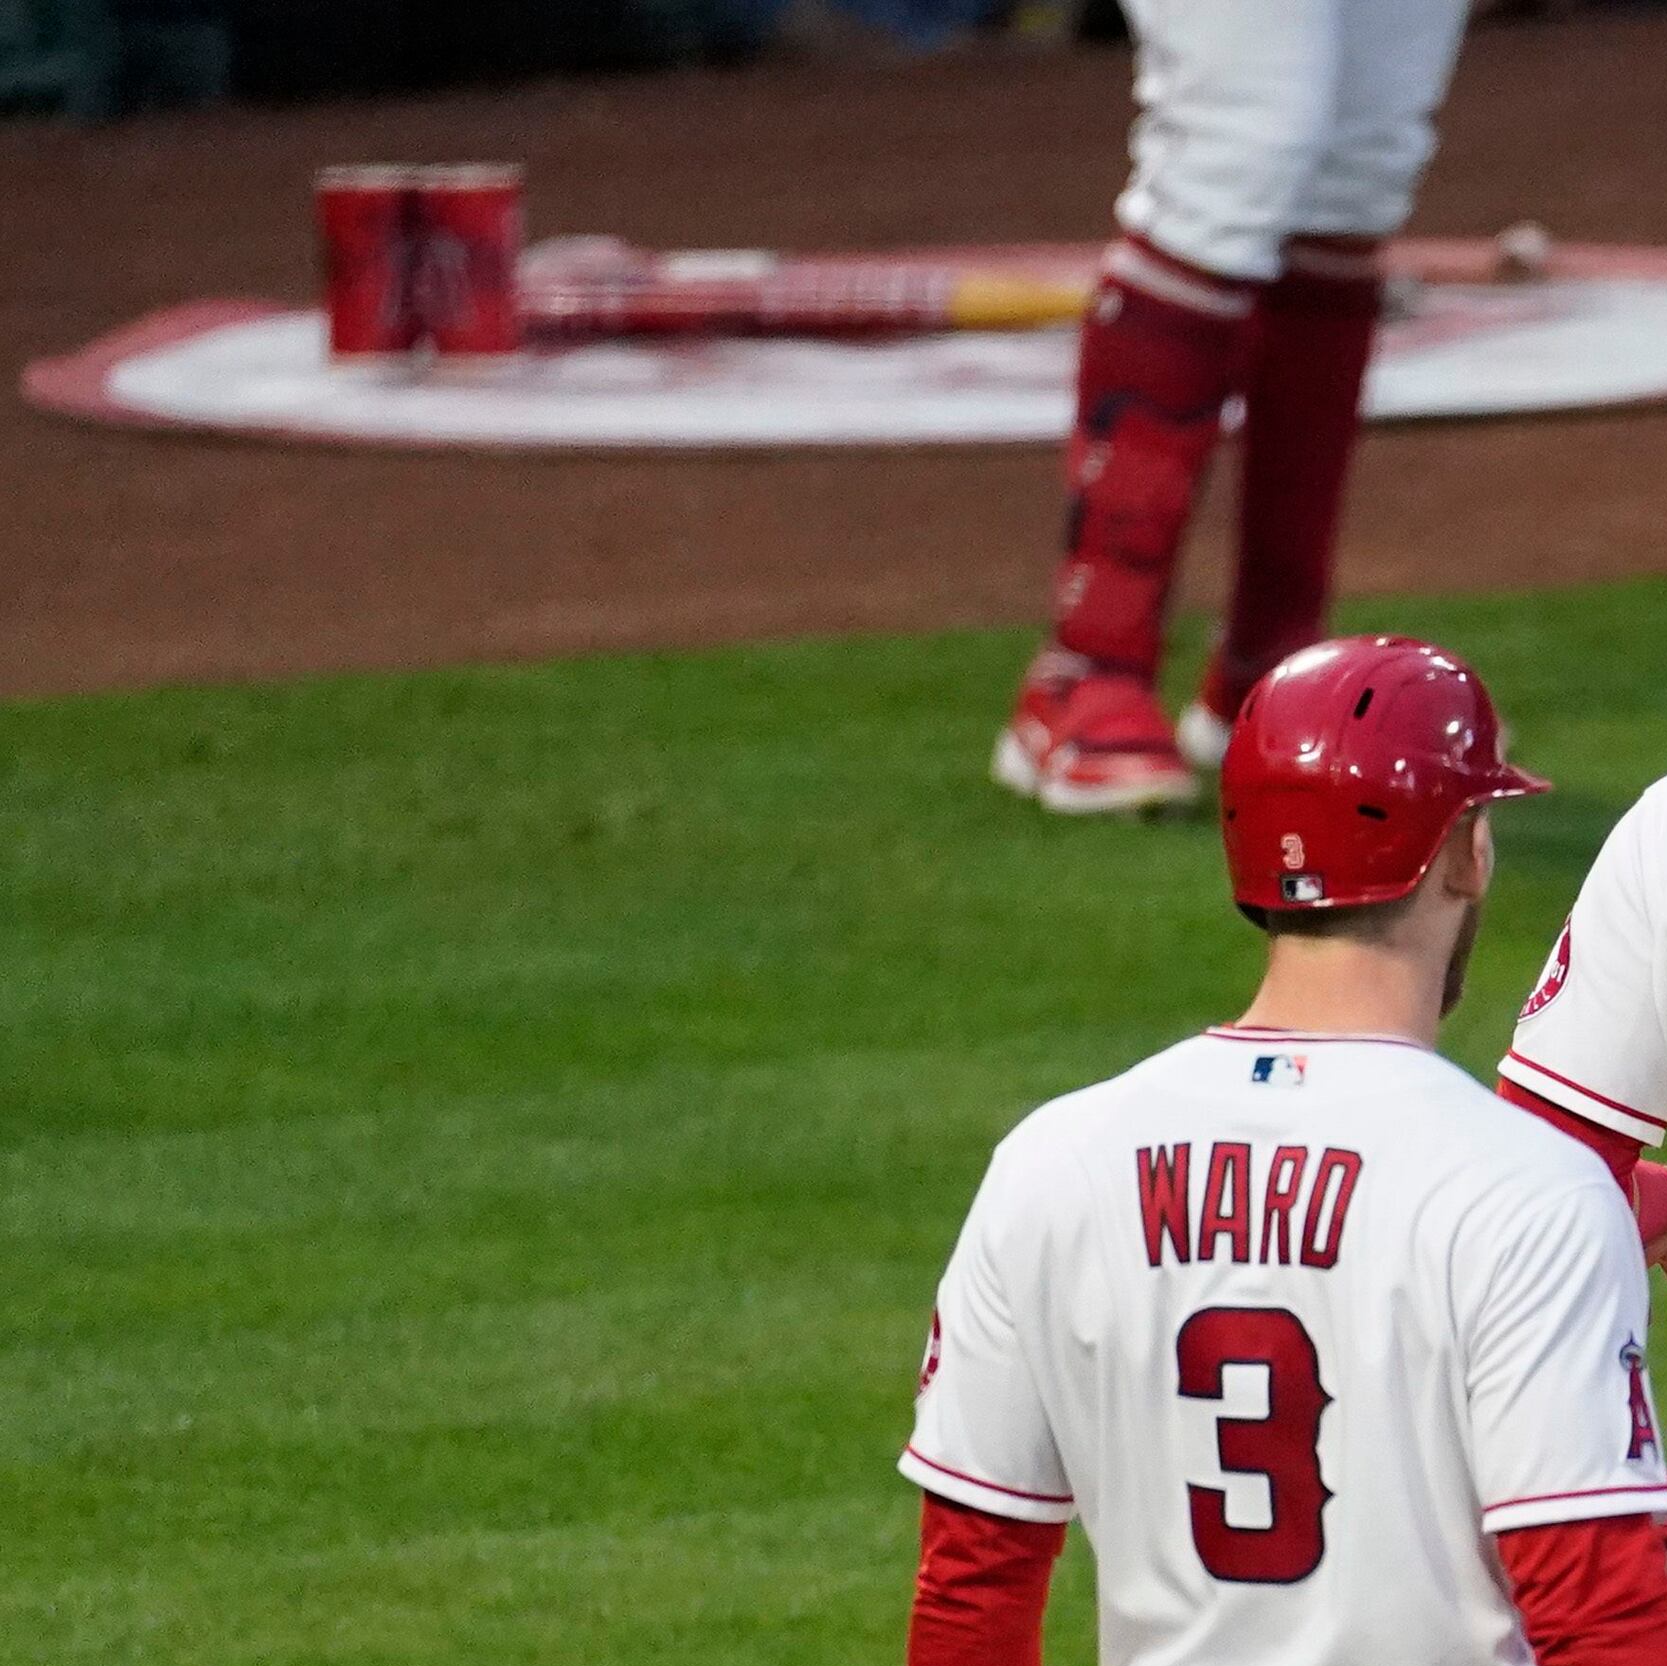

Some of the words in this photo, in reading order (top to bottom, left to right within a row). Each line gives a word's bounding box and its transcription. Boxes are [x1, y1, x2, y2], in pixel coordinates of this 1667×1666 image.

[1281, 833, 1305, 869] 3
[1136, 1142, 1362, 1271] WARD
[1176, 1306, 1335, 1585] 3
